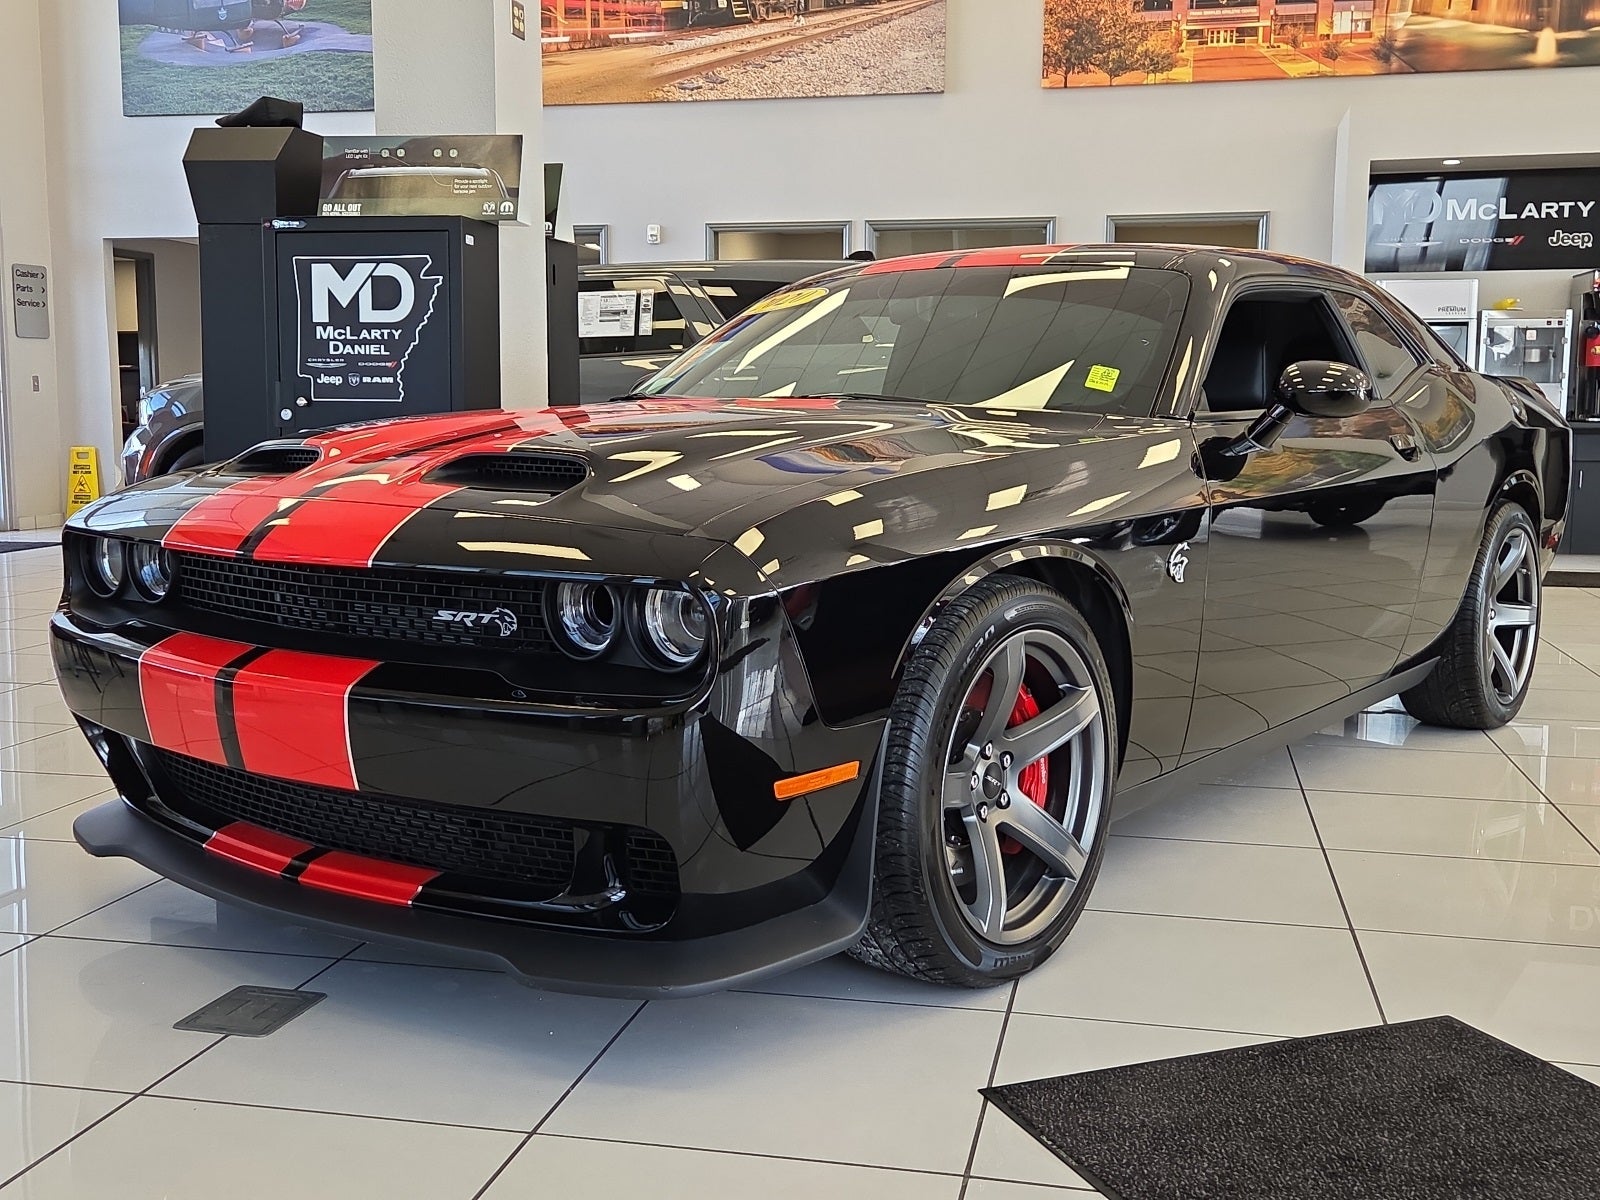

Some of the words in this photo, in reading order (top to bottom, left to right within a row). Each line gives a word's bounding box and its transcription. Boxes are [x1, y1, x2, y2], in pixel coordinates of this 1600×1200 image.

[323, 203, 333, 212] GO
[333, 203, 346, 212] ALL
[347, 203, 362, 212] OUT
[1446, 197, 1596, 221] McLARTY
[1459, 236, 1513, 245] DODGE
[1548, 229, 1594, 249] Jeep
[15, 269, 40, 278] Cashier
[16, 283, 34, 293] Parts
[311, 262, 415, 323] MD
[16, 298, 41, 308] Service
[316, 326, 402, 340] McLARTY
[329, 341, 390, 355] DANIEL
[316, 373, 343, 386] Jeep
[432, 609, 500, 627] SRT
[985, 775, 1002, 786] SRT
